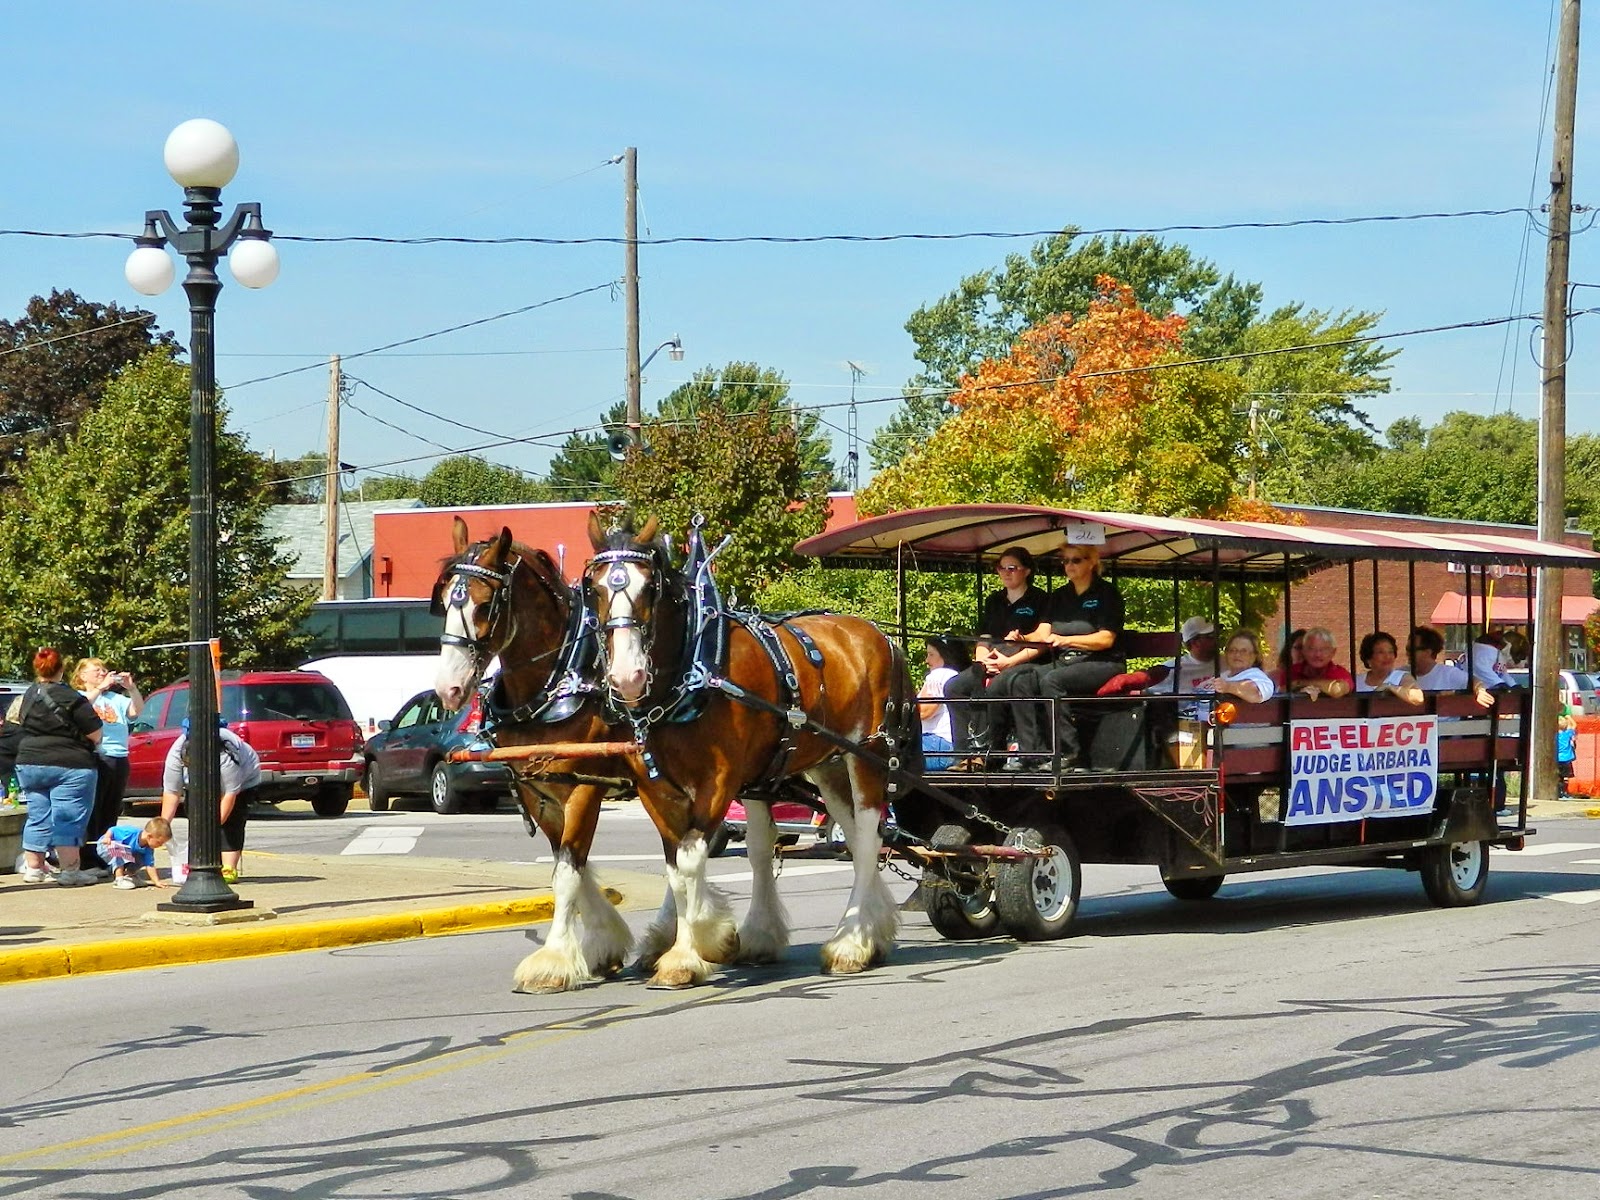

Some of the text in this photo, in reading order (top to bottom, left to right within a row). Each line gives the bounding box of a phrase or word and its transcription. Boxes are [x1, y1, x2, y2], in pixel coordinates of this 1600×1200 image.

[1292, 721, 1434, 751] RE-ELECT
[1293, 753, 1351, 775] JUDGE
[1288, 771, 1433, 817] ANSTED
